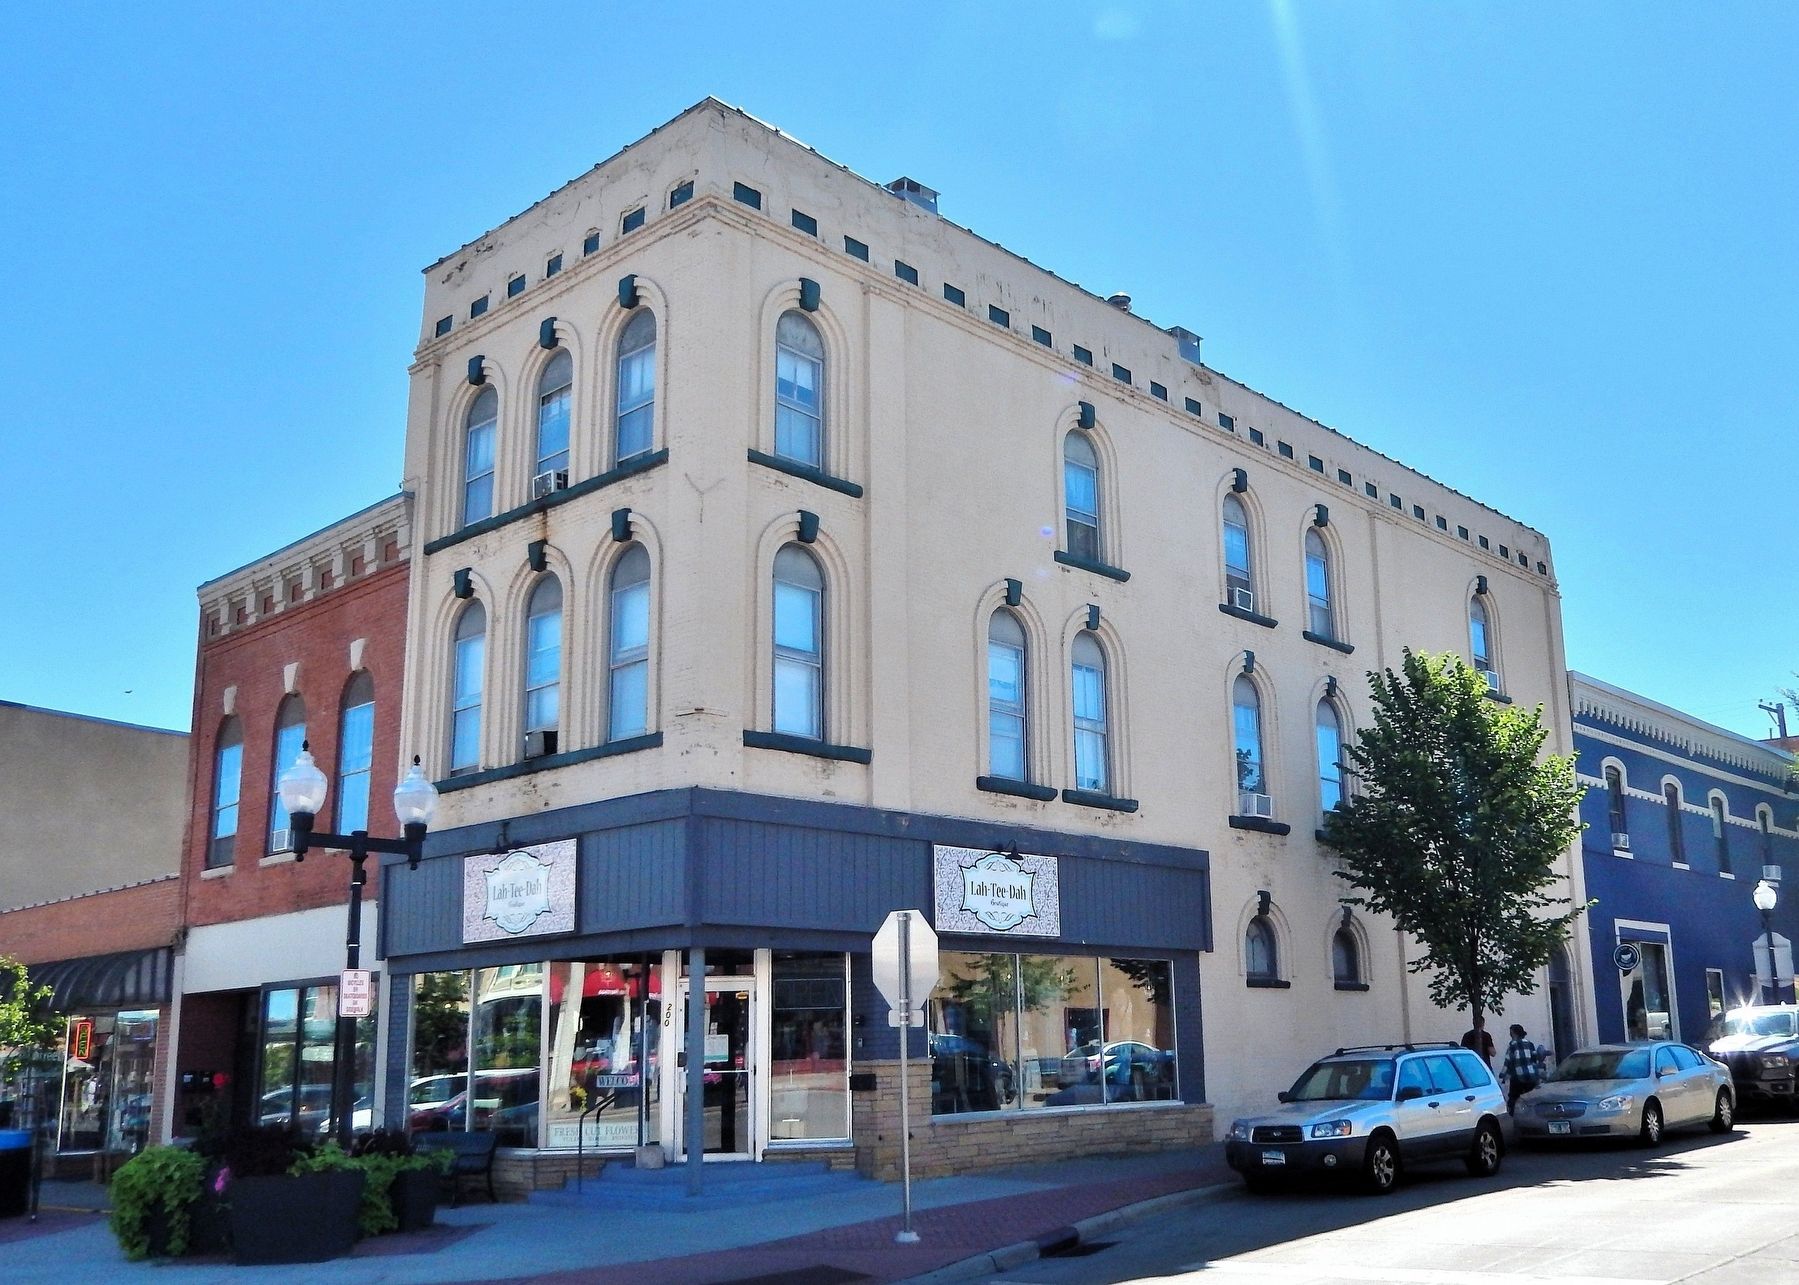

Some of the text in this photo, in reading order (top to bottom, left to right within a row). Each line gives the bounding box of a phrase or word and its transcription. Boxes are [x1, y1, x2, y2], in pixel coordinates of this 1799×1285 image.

[970, 881, 1026, 900] Lah-Tee-Dah
[664, 1003, 673, 1027] 200
[599, 1075, 638, 1087] WELCO
